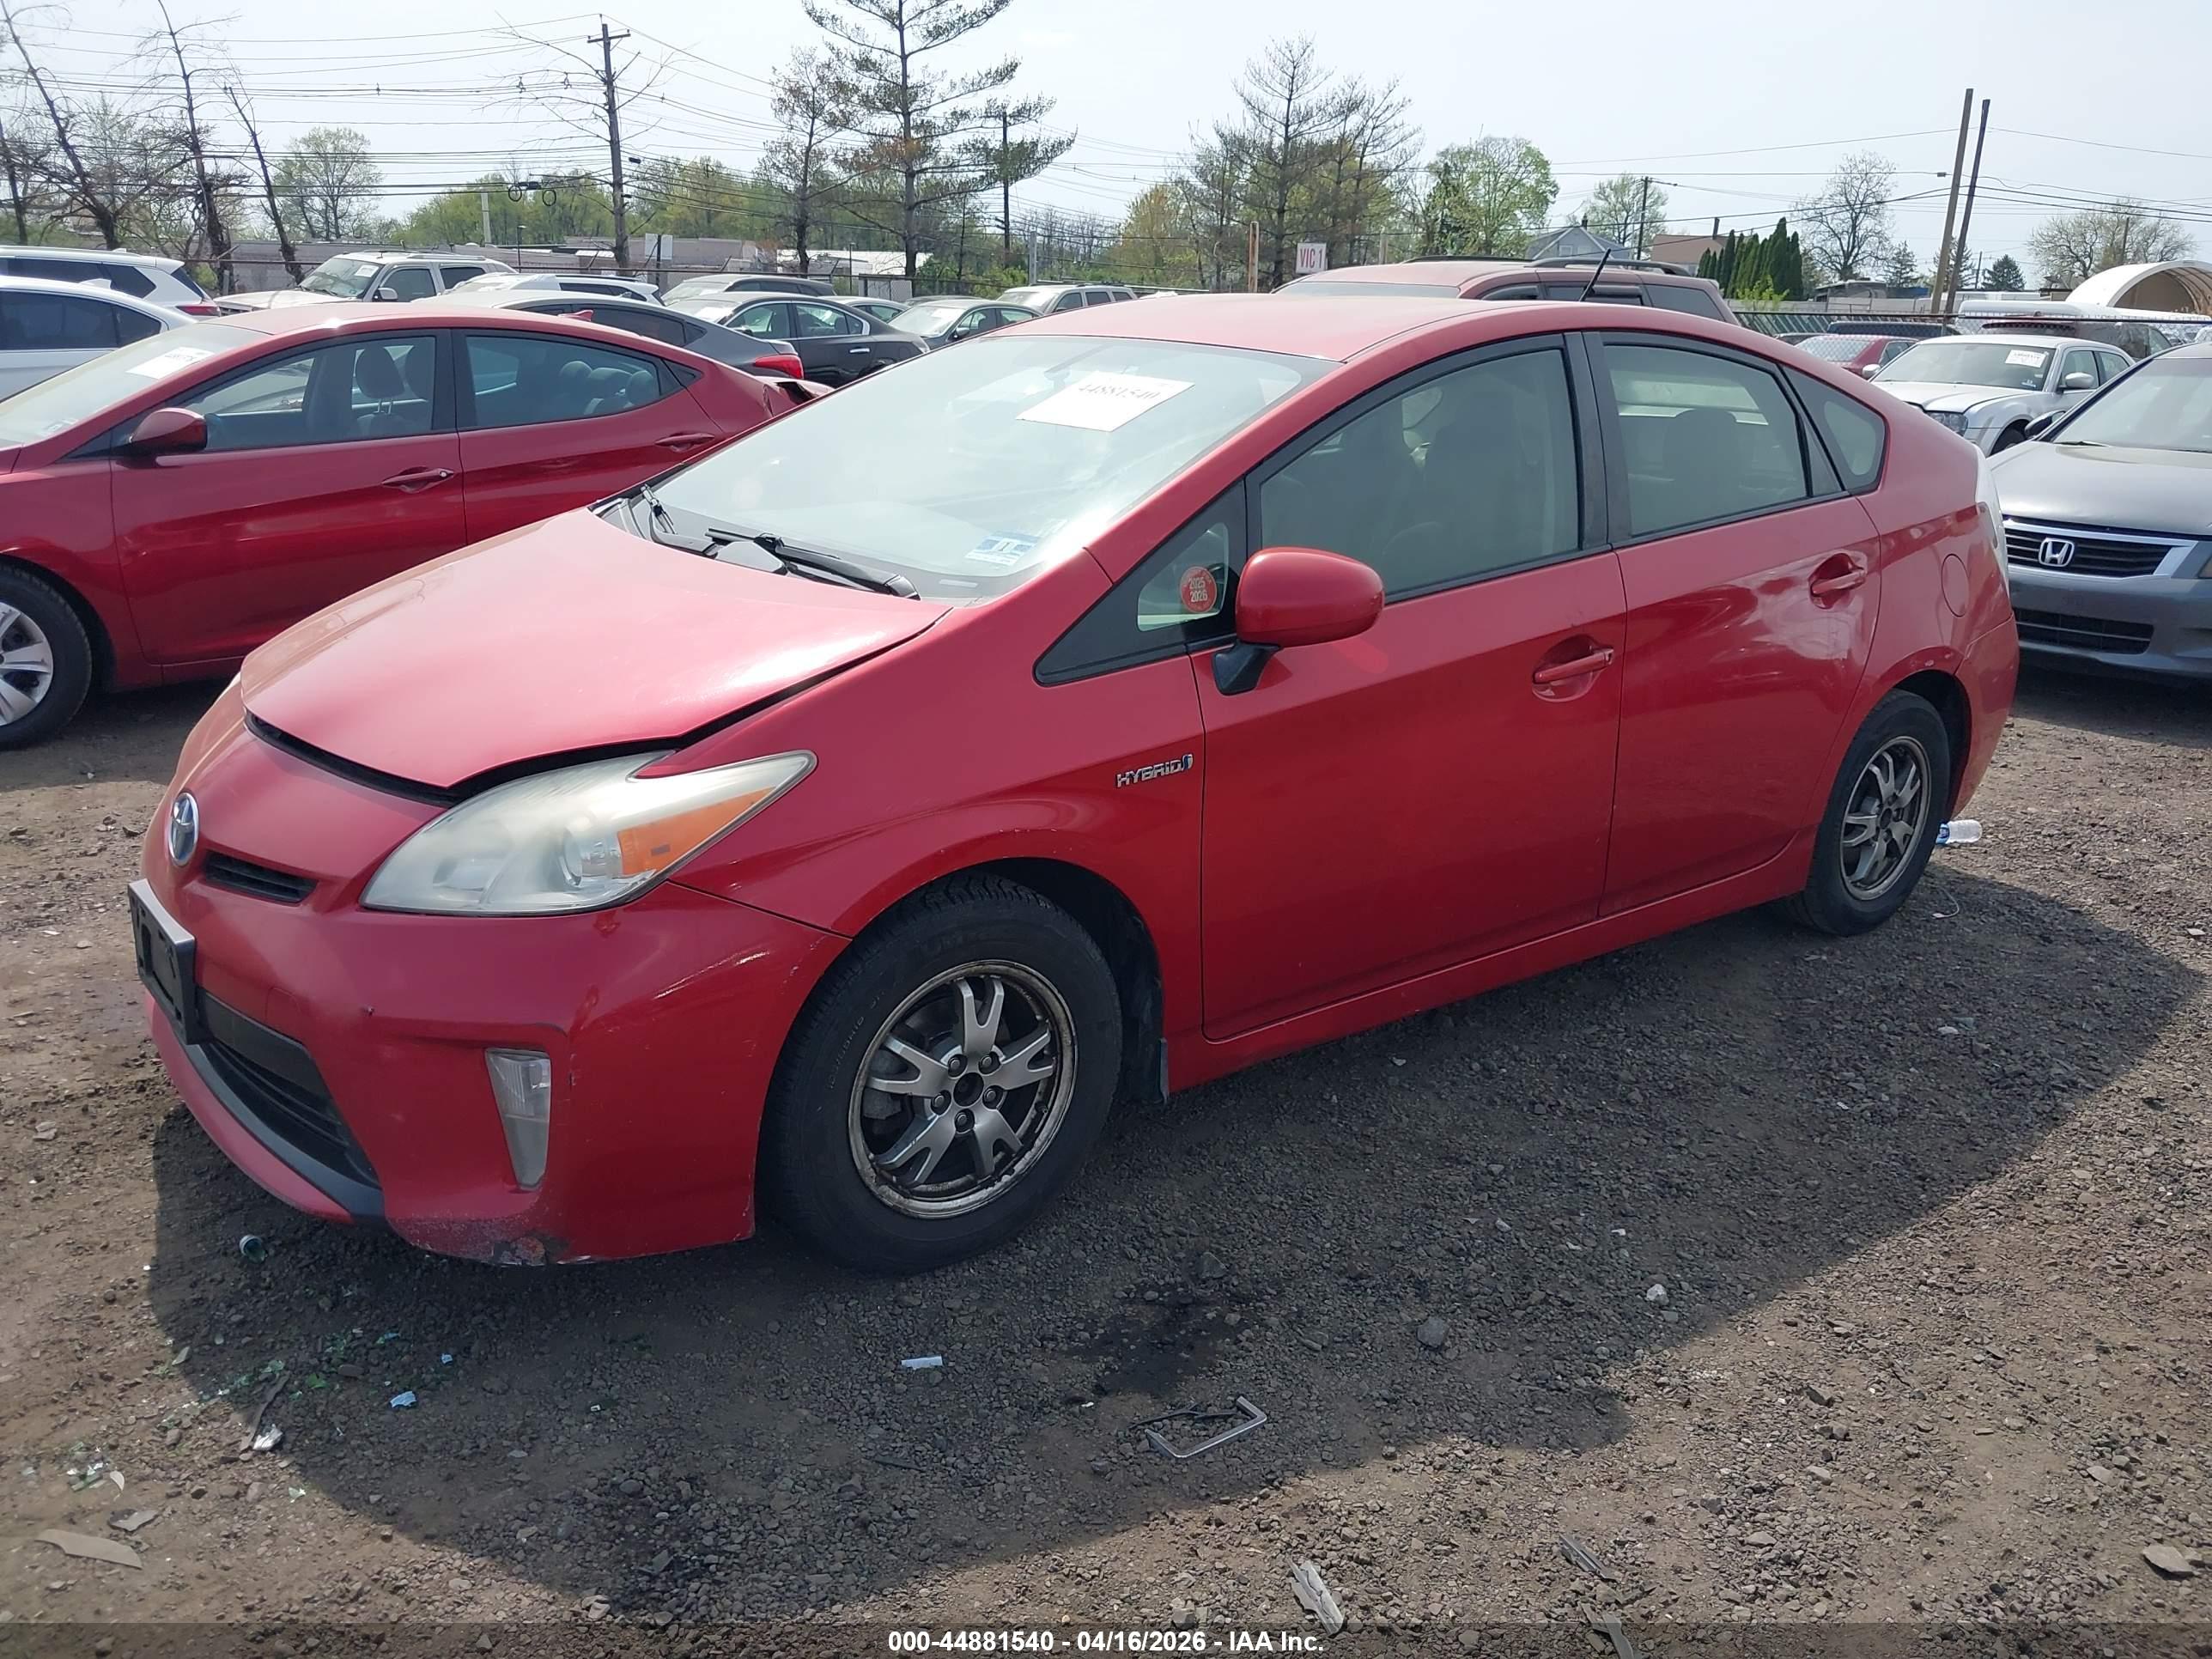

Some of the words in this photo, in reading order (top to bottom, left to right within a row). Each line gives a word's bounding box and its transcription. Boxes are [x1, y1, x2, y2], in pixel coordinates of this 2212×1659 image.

[1299, 248, 1316, 269] VIC
[1318, 248, 1323, 269] 1
[1188, 576, 1206, 590] 2025
[1189, 590, 1208, 603] 2026
[1115, 759, 1182, 788] HYBRID
